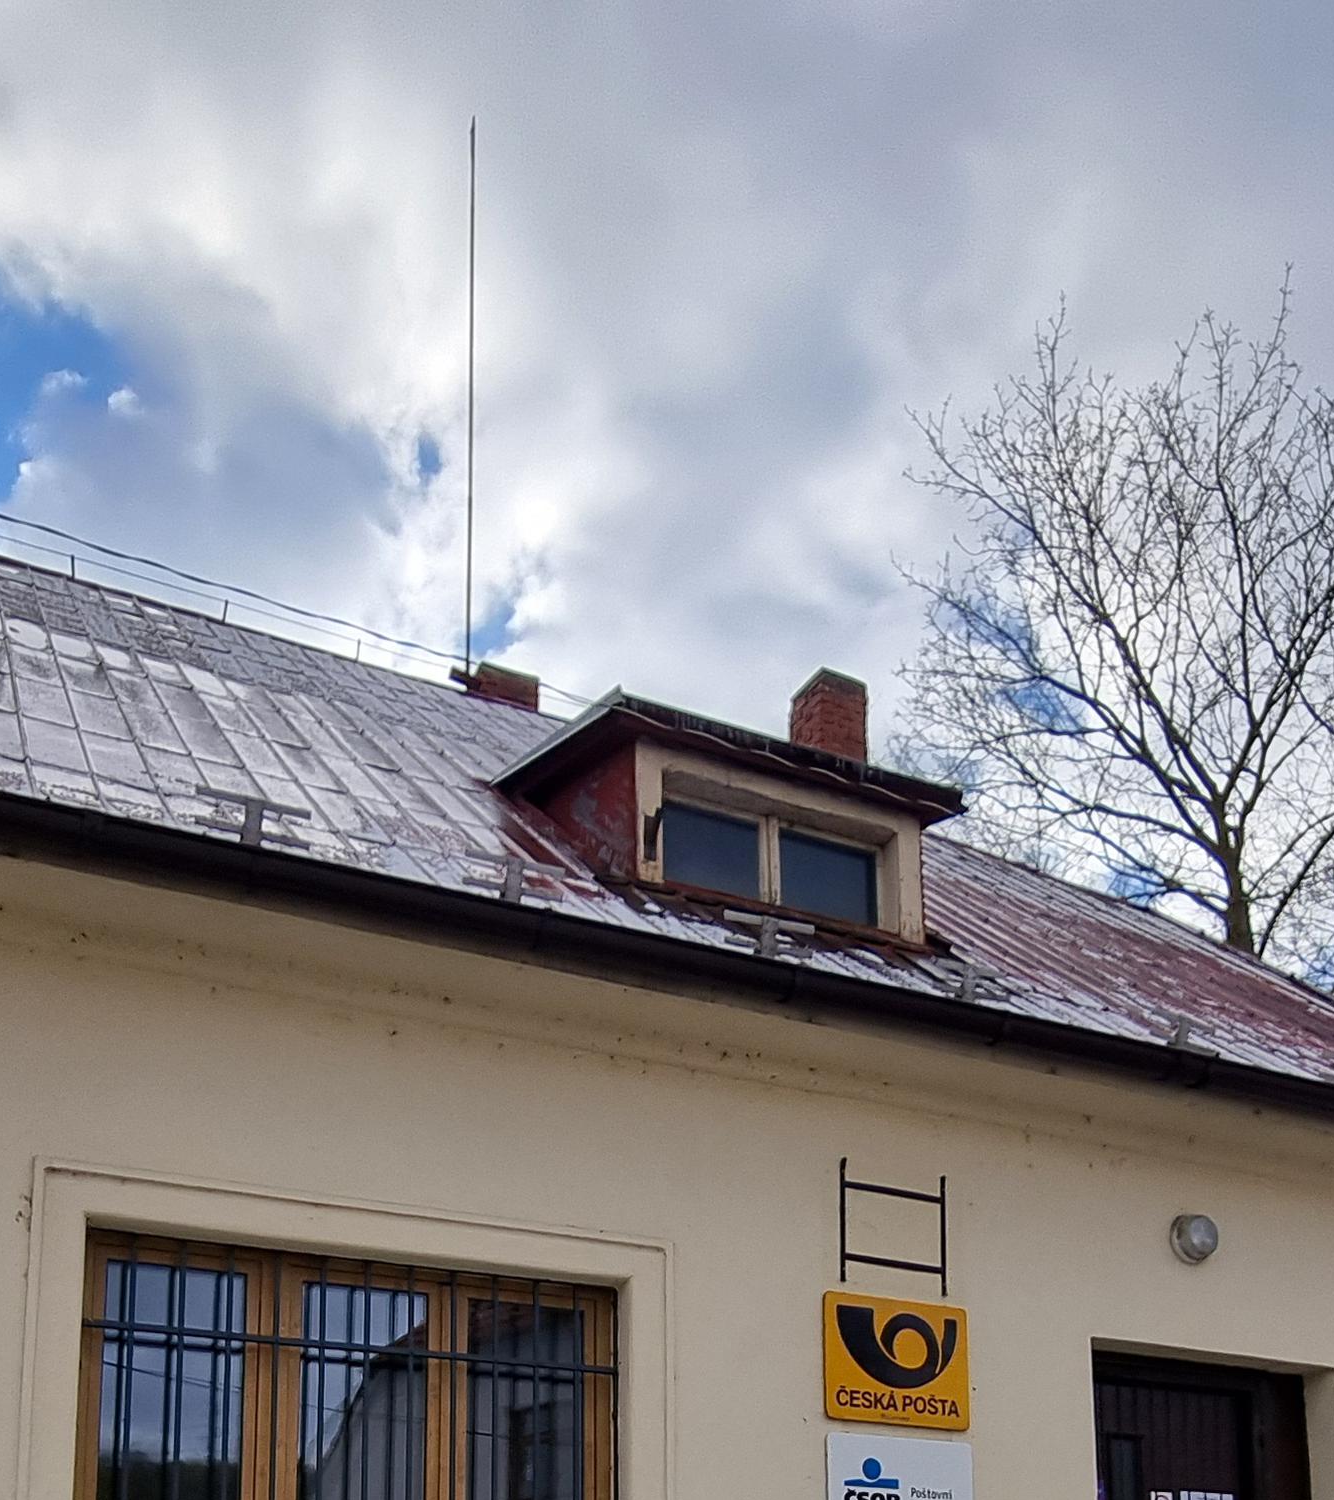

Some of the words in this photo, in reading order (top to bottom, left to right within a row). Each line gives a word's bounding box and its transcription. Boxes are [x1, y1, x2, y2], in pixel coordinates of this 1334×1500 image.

[835, 1385, 899, 1412] ČESKÁ
[901, 1394, 960, 1418] POŠTA
[910, 1487, 953, 1500] Poštovní
